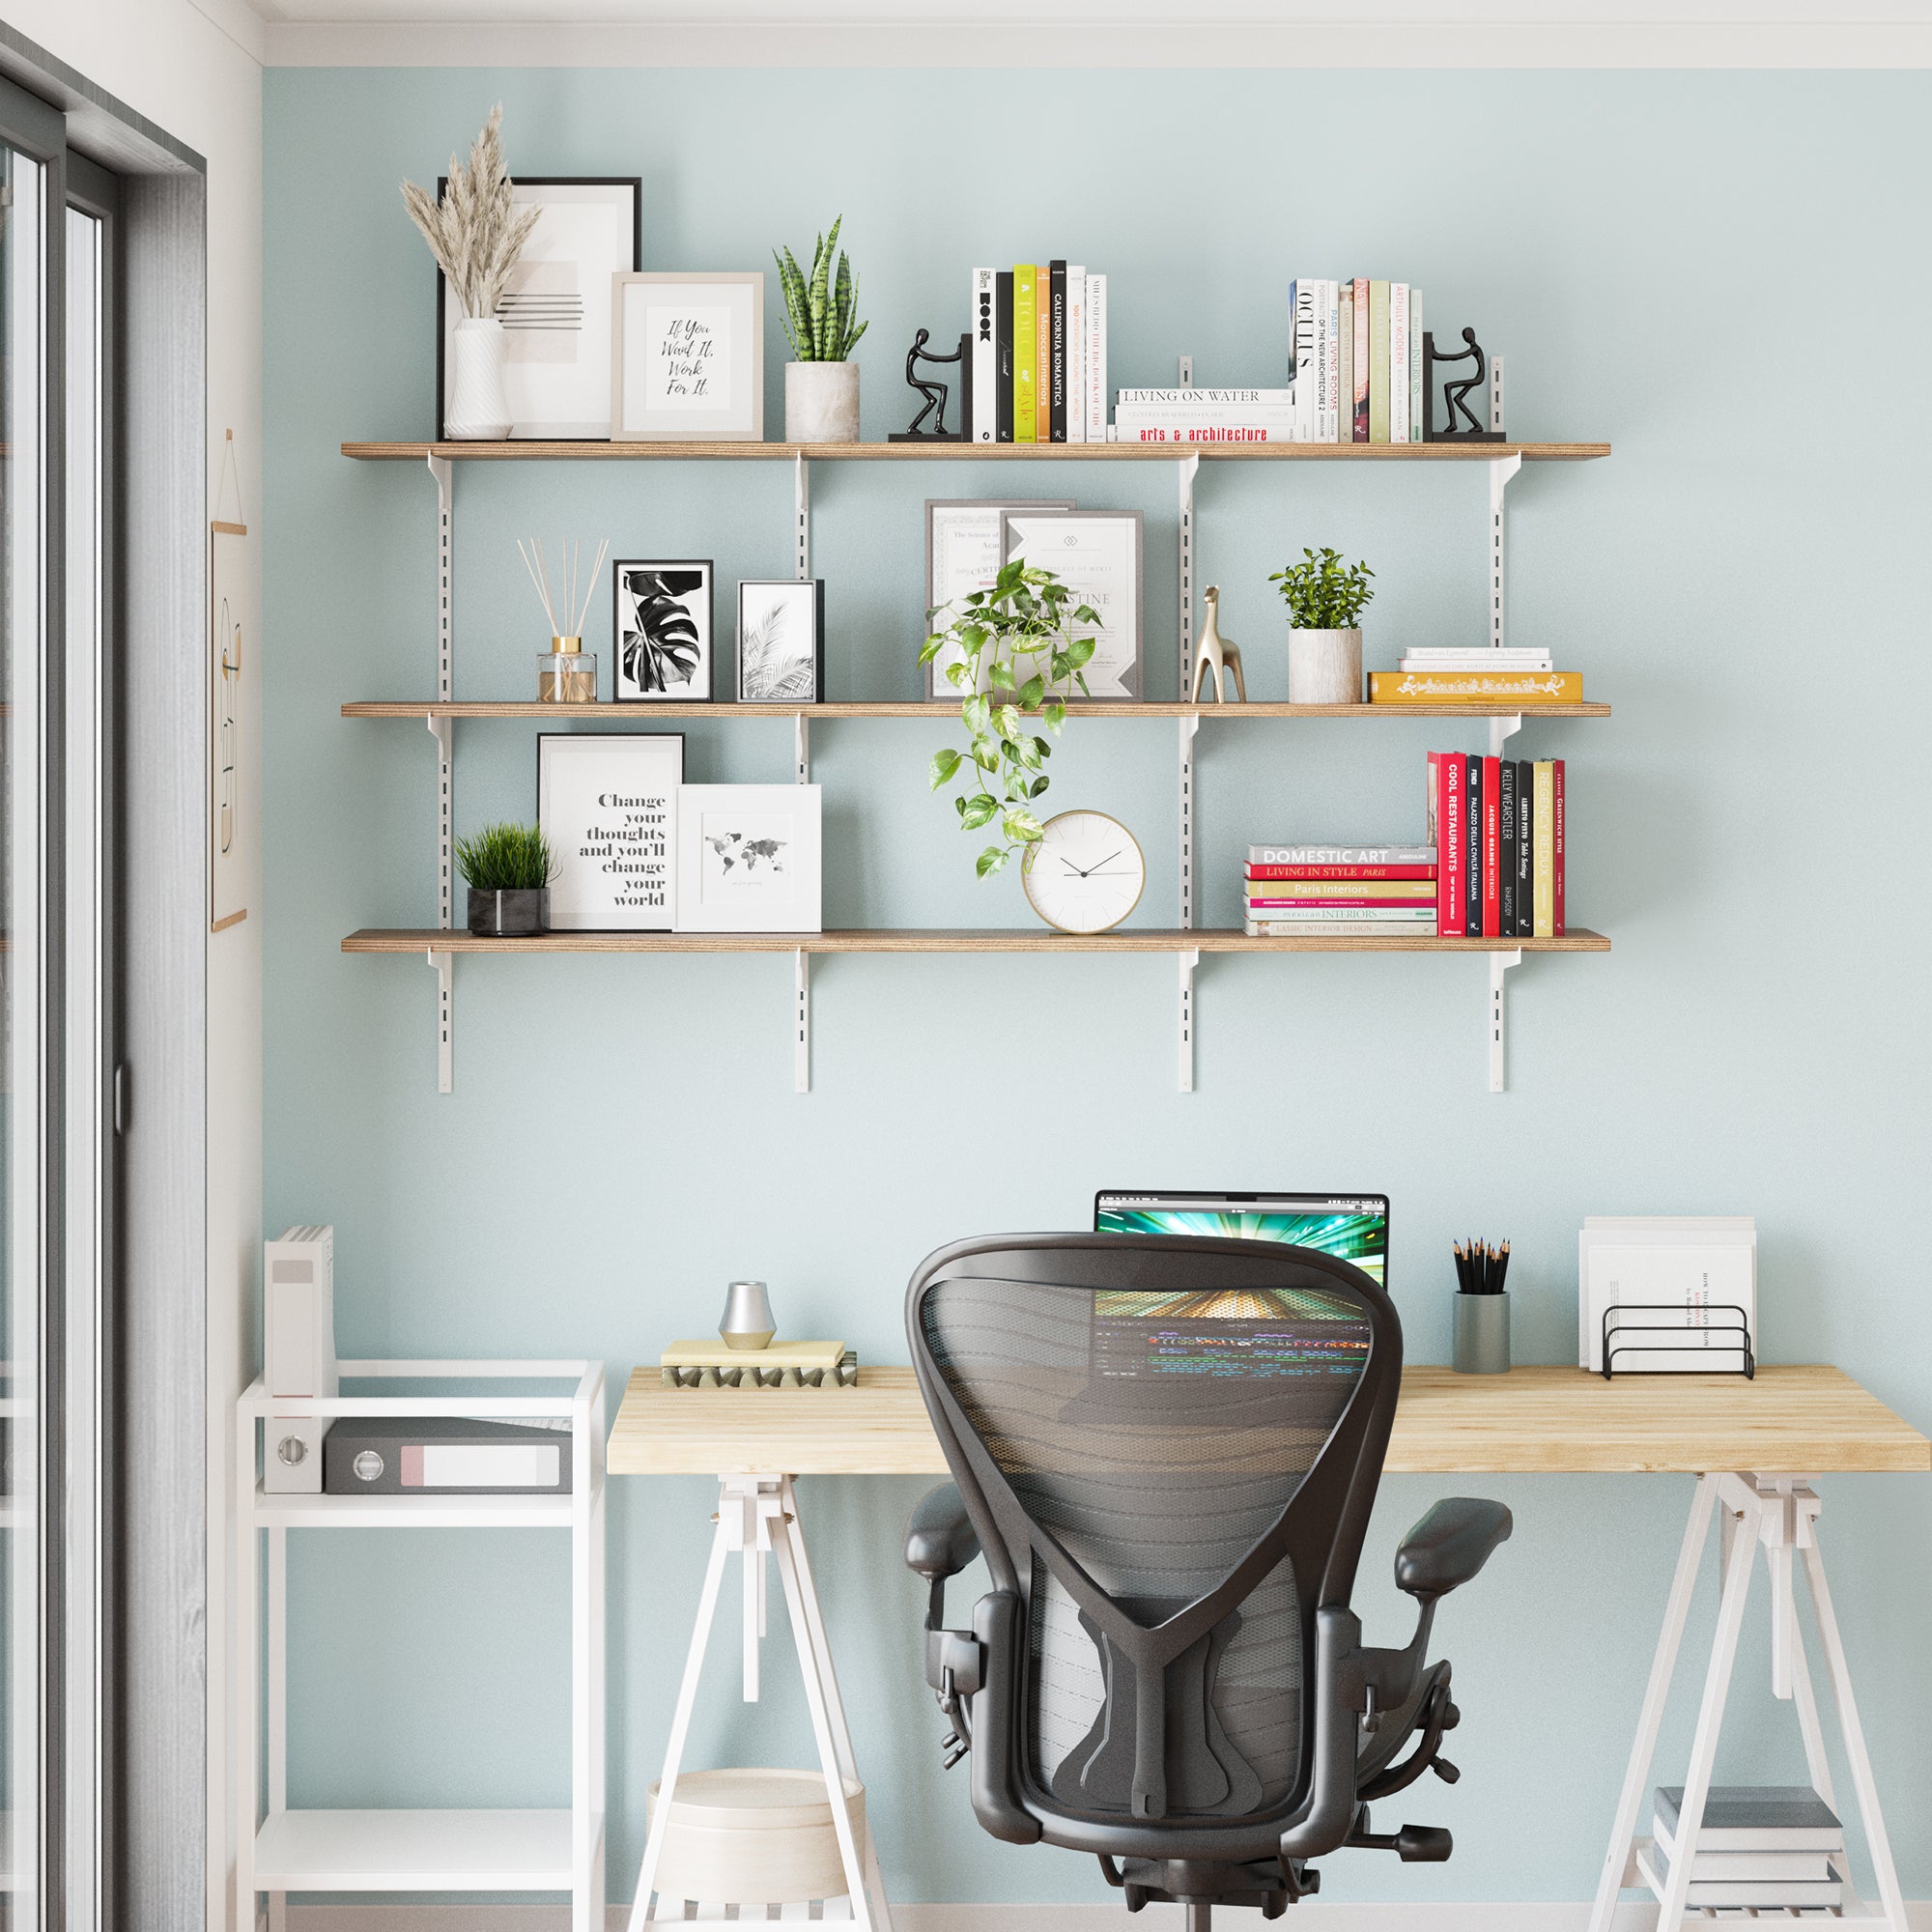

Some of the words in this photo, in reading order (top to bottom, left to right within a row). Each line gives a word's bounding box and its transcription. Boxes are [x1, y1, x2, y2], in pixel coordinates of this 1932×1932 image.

[1021, 284, 1030, 293] A
[1356, 285, 1367, 307] NEW
[1395, 286, 1404, 325] ARTFULLY
[980, 293, 991, 342] BOOK
[1054, 294, 1063, 351] CALIFORNIA
[1319, 319, 1325, 327] OF
[667, 320, 684, 338] If
[685, 319, 711, 339] You
[1040, 314, 1049, 363] Moroccan
[1297, 292, 1314, 368] OCULUS
[662, 341, 695, 356] Want
[1395, 327, 1404, 364] MODERN
[669, 360, 703, 377] Work
[1411, 349, 1421, 394] INTERIORS
[666, 379, 689, 395] For
[1040, 364, 1049, 406] Interiors
[1054, 353, 1063, 407] ROMANTICA
[1124, 390, 1178, 402] LIVING
[1182, 390, 1203, 402] ON
[1208, 390, 1260, 402] WATER
[1140, 428, 1165, 441] arts
[1174, 430, 1181, 441] &
[1189, 427, 1267, 441] architecture
[1448, 764, 1458, 792] COOL
[1502, 769, 1512, 791] KELLY
[598, 793, 666, 810] Change
[1539, 772, 1549, 831] REGENCY
[624, 811, 666, 827] your
[1502, 793, 1512, 839] WEARSTLER
[586, 826, 666, 841] thoughts
[1448, 796, 1458, 871] RESTAURANTS
[580, 842, 612, 857] and
[616, 842, 666, 860] you'll
[1264, 850, 1352, 863] DOMESTIC
[1357, 850, 1388, 863] ART
[1470, 847, 1479, 870] CIVILTÀ
[1539, 835, 1549, 877] REDUX
[602, 860, 666, 874] change
[1266, 867, 1305, 876] LIVING
[1307, 867, 1321, 876] IN
[1322, 867, 1358, 876] STYLE
[1519, 858, 1528, 879] Settings
[624, 878, 666, 892] your
[1294, 884, 1321, 894] Paris
[1322, 884, 1369, 894] Interiors
[613, 893, 666, 906] world
[1321, 909, 1378, 919] INTERIORS
[1702, 1291, 1709, 1300] TO
